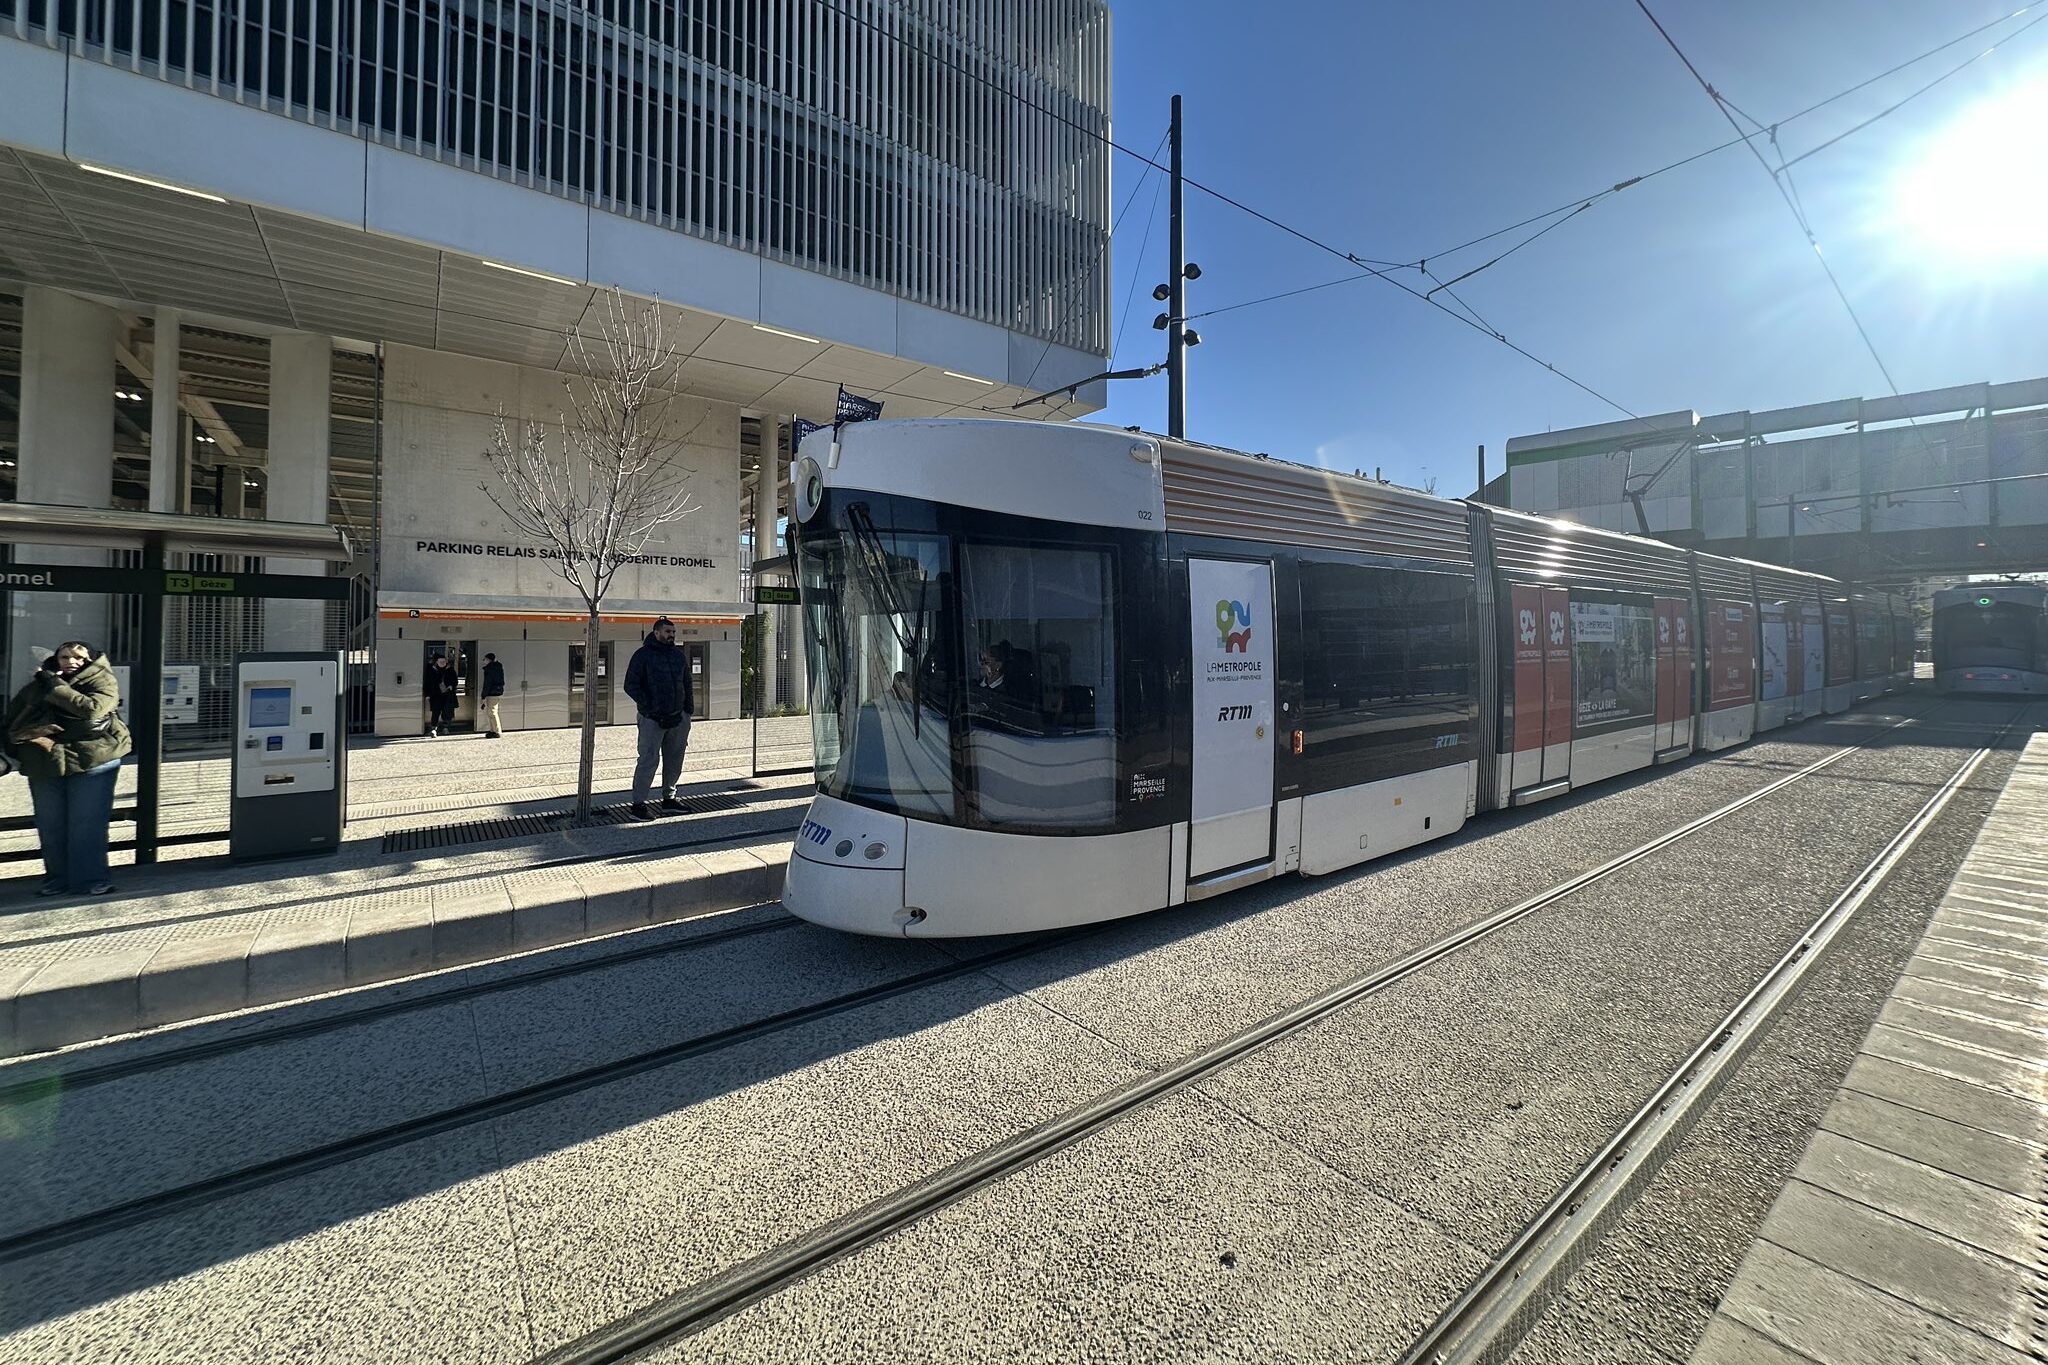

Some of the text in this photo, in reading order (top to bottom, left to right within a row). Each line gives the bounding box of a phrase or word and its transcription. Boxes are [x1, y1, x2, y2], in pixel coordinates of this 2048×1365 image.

[1138, 510, 1152, 521] 022
[416, 541, 483, 555] PARKING
[486, 545, 536, 558] RELAIS
[589, 551, 668, 566] MRGUERITE
[670, 556, 716, 568] DROMEL
[169, 576, 190, 588] T3
[761, 591, 772, 599] T3
[1217, 704, 1253, 722] RTM
[1435, 733, 1458, 749] RTM
[1133, 778, 1166, 788] MARSEILLE
[1133, 785, 1166, 795] PROVENCE
